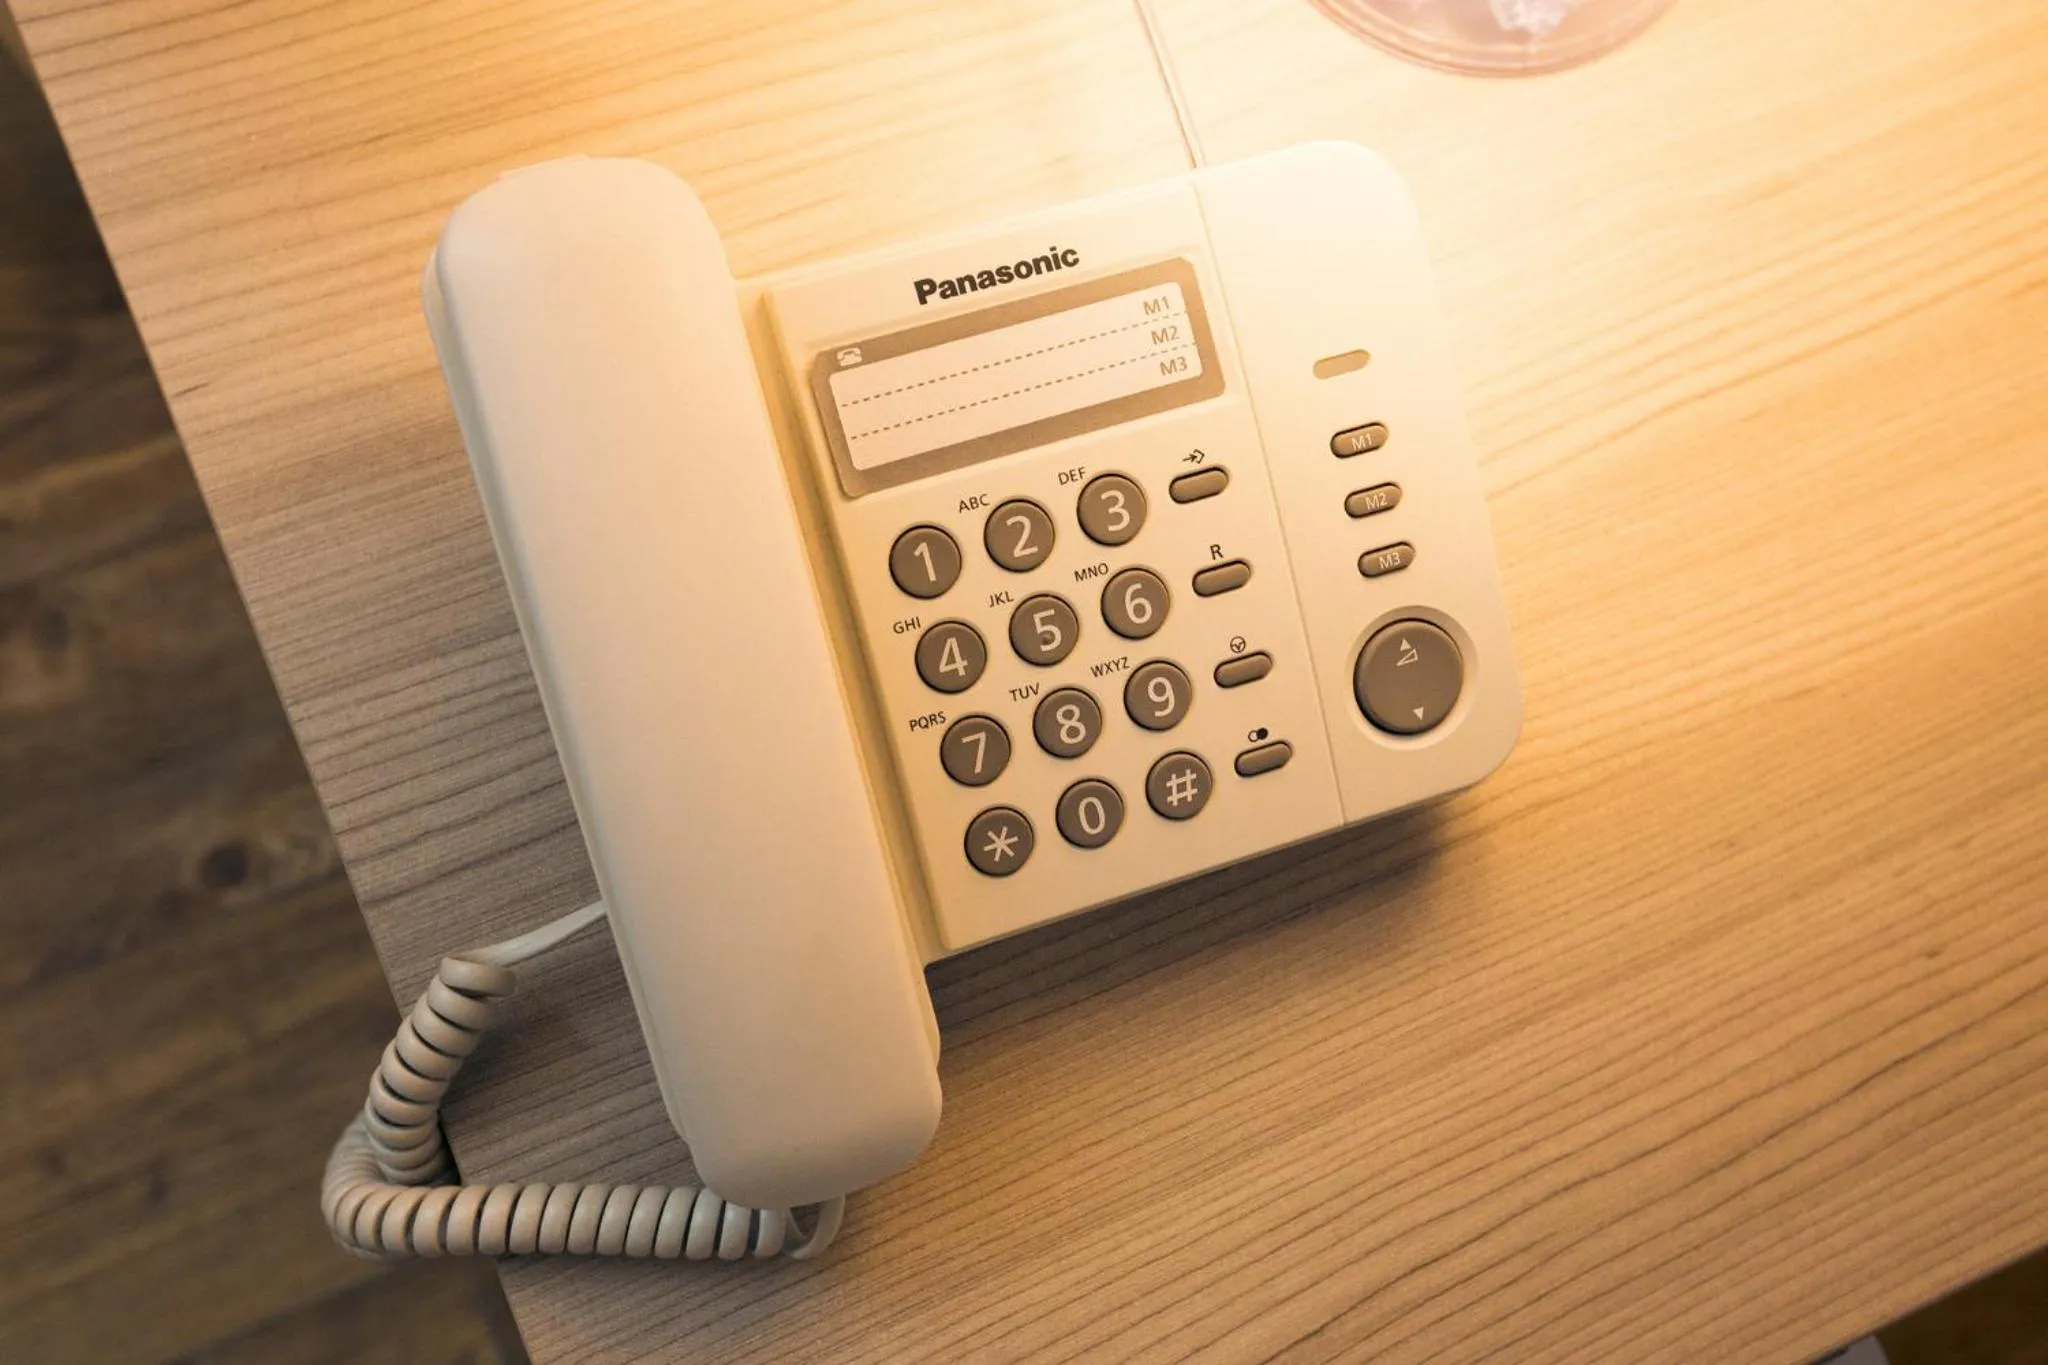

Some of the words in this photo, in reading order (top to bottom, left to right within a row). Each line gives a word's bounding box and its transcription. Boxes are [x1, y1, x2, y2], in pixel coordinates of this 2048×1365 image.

[913, 245, 1080, 306] Panasonic
[1143, 295, 1171, 316] M1
[1150, 326, 1180, 346] M2
[1159, 358, 1188, 378] M3
[1351, 433, 1373, 450] M1
[1058, 467, 1087, 487] DEF
[958, 493, 990, 514] ABC
[1100, 489, 1131, 532] 3
[1365, 493, 1388, 510] M2
[1006, 515, 1039, 558] 2
[913, 541, 937, 582] 1
[1209, 543, 1224, 560] R
[1378, 552, 1401, 570] M3
[1073, 563, 1109, 583] MNO
[988, 590, 1014, 608] JKL
[1124, 582, 1153, 625] 6
[892, 616, 922, 636] GHI
[1032, 609, 1062, 652] 5
[938, 636, 969, 677] 4
[1090, 656, 1131, 679] WXYZ
[1009, 683, 1042, 703] TUV
[1146, 676, 1176, 718] 9
[909, 711, 947, 732] PQRS
[1055, 703, 1087, 745] 8
[961, 731, 987, 775] 7
[1166, 768, 1199, 807] #
[1078, 796, 1107, 836] 0
